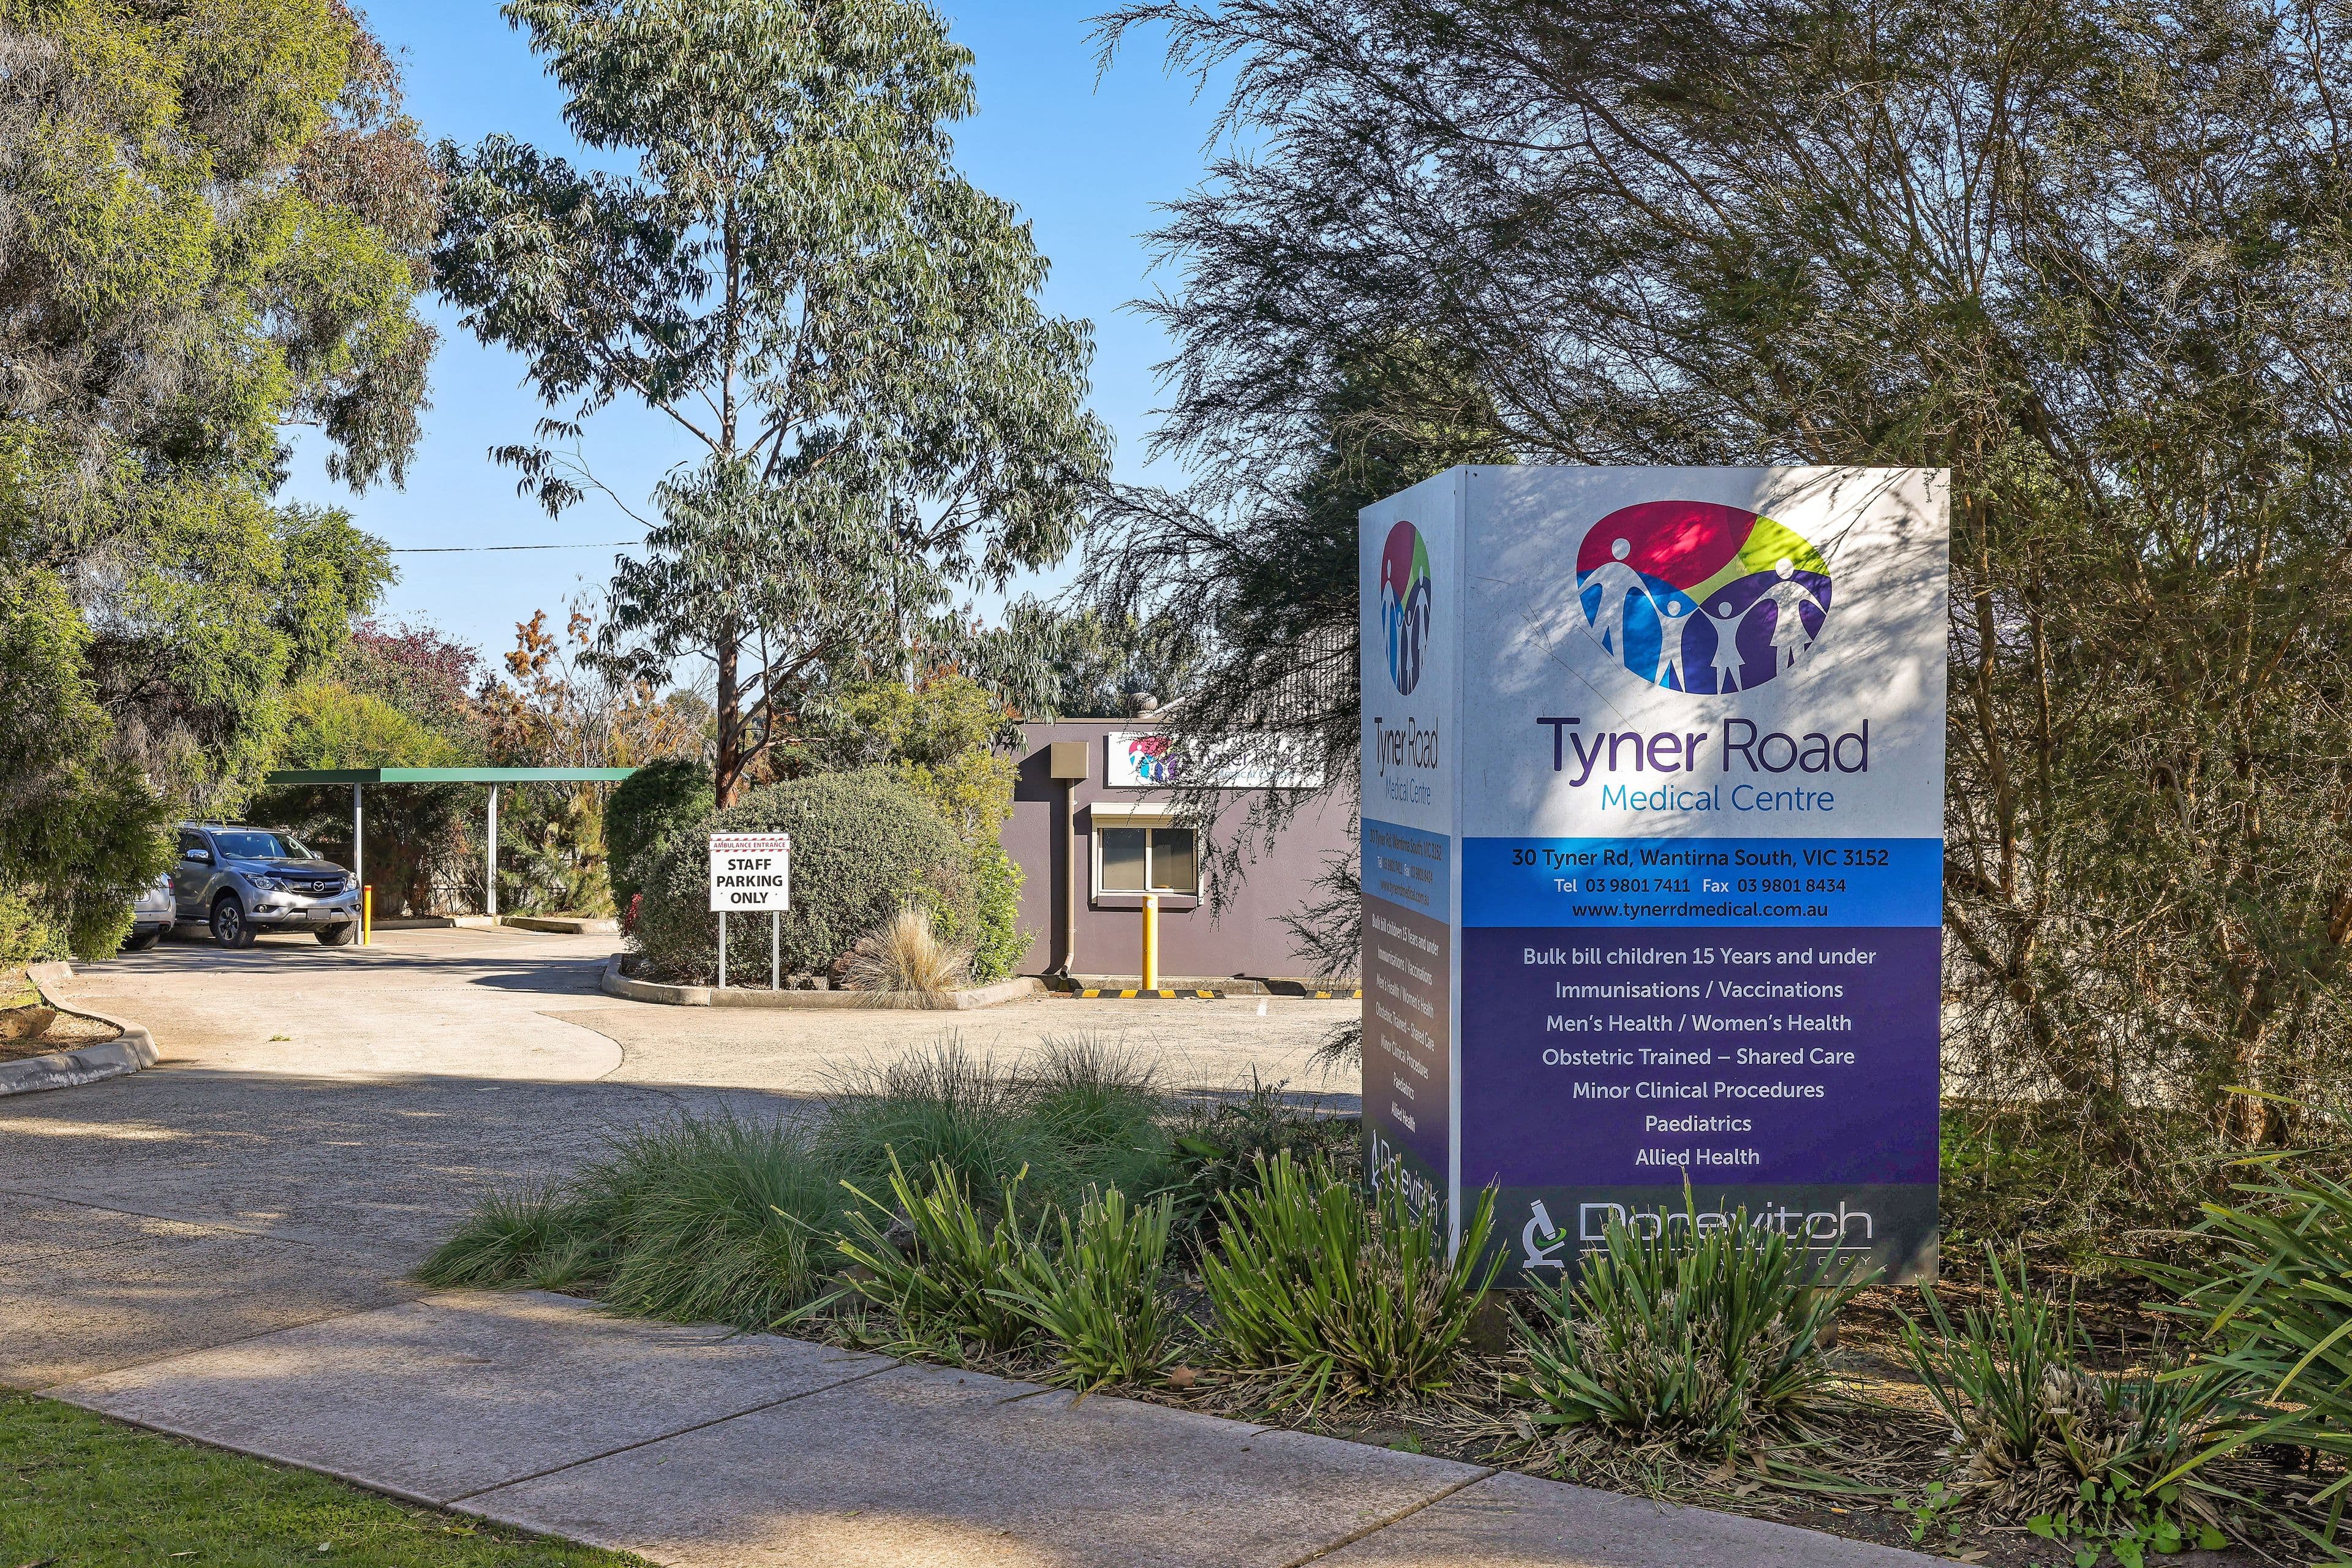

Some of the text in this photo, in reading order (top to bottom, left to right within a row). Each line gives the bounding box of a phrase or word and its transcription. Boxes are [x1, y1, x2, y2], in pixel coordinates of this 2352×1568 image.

[1374, 717, 1438, 777] Tyner Road
[1537, 718, 1868, 787] Tyner Road
[1385, 775, 1431, 805] Medical Centre
[1602, 785, 1834, 811] Medical Centre
[728, 859, 771, 870] STAFF
[1512, 849, 1888, 870] 30 Tyner Rd, Wantirna South, VIC 3152
[717, 875, 783, 887] PARKING
[1554, 879, 1845, 892] Tel 03 9801 7411 Fax 03 9801 8434
[731, 892, 769, 903] ONLY
[1573, 902, 1827, 920] www.tynerrdmedical.com.au
[1372, 913, 1381, 929] Bulk
[1387, 920, 1402, 939] children
[1403, 926, 1408, 941] 15
[1408, 928, 1418, 946] Years
[1427, 939, 1439, 956] under
[1378, 944, 1404, 971] Immunisations
[1408, 958, 1432, 986] Vaccinations
[1525, 948, 1876, 964] Bulk bill children 15 Years and under
[1387, 978, 1400, 999] Health
[1420, 997, 1434, 1019] Health
[1557, 981, 1843, 998] Immunisations / Vaccinations
[1376, 1001, 1392, 1024] Obstetric
[1393, 1011, 1407, 1033] Trained
[1411, 1022, 1424, 1045] Shared
[1425, 1031, 1434, 1052] Care
[1610, 1015, 1672, 1031] Health
[1678, 1014, 1686, 1031] /
[1789, 1015, 1851, 1030] Health
[1381, 1034, 1428, 1079] Minor Clinical Procedures
[1543, 1049, 1633, 1065] Obstetric
[1638, 1049, 1710, 1065] Trained
[1737, 1048, 1803, 1064] Shared
[1810, 1048, 1854, 1064] Care
[1393, 1072, 1414, 1101] Paediatrics
[1574, 1082, 1824, 1098] Minor Clinical Procedures
[1392, 1101, 1415, 1133] Allied Health
[1646, 1115, 1751, 1131] Paediatrics
[1636, 1148, 1759, 1165] Allied Health
